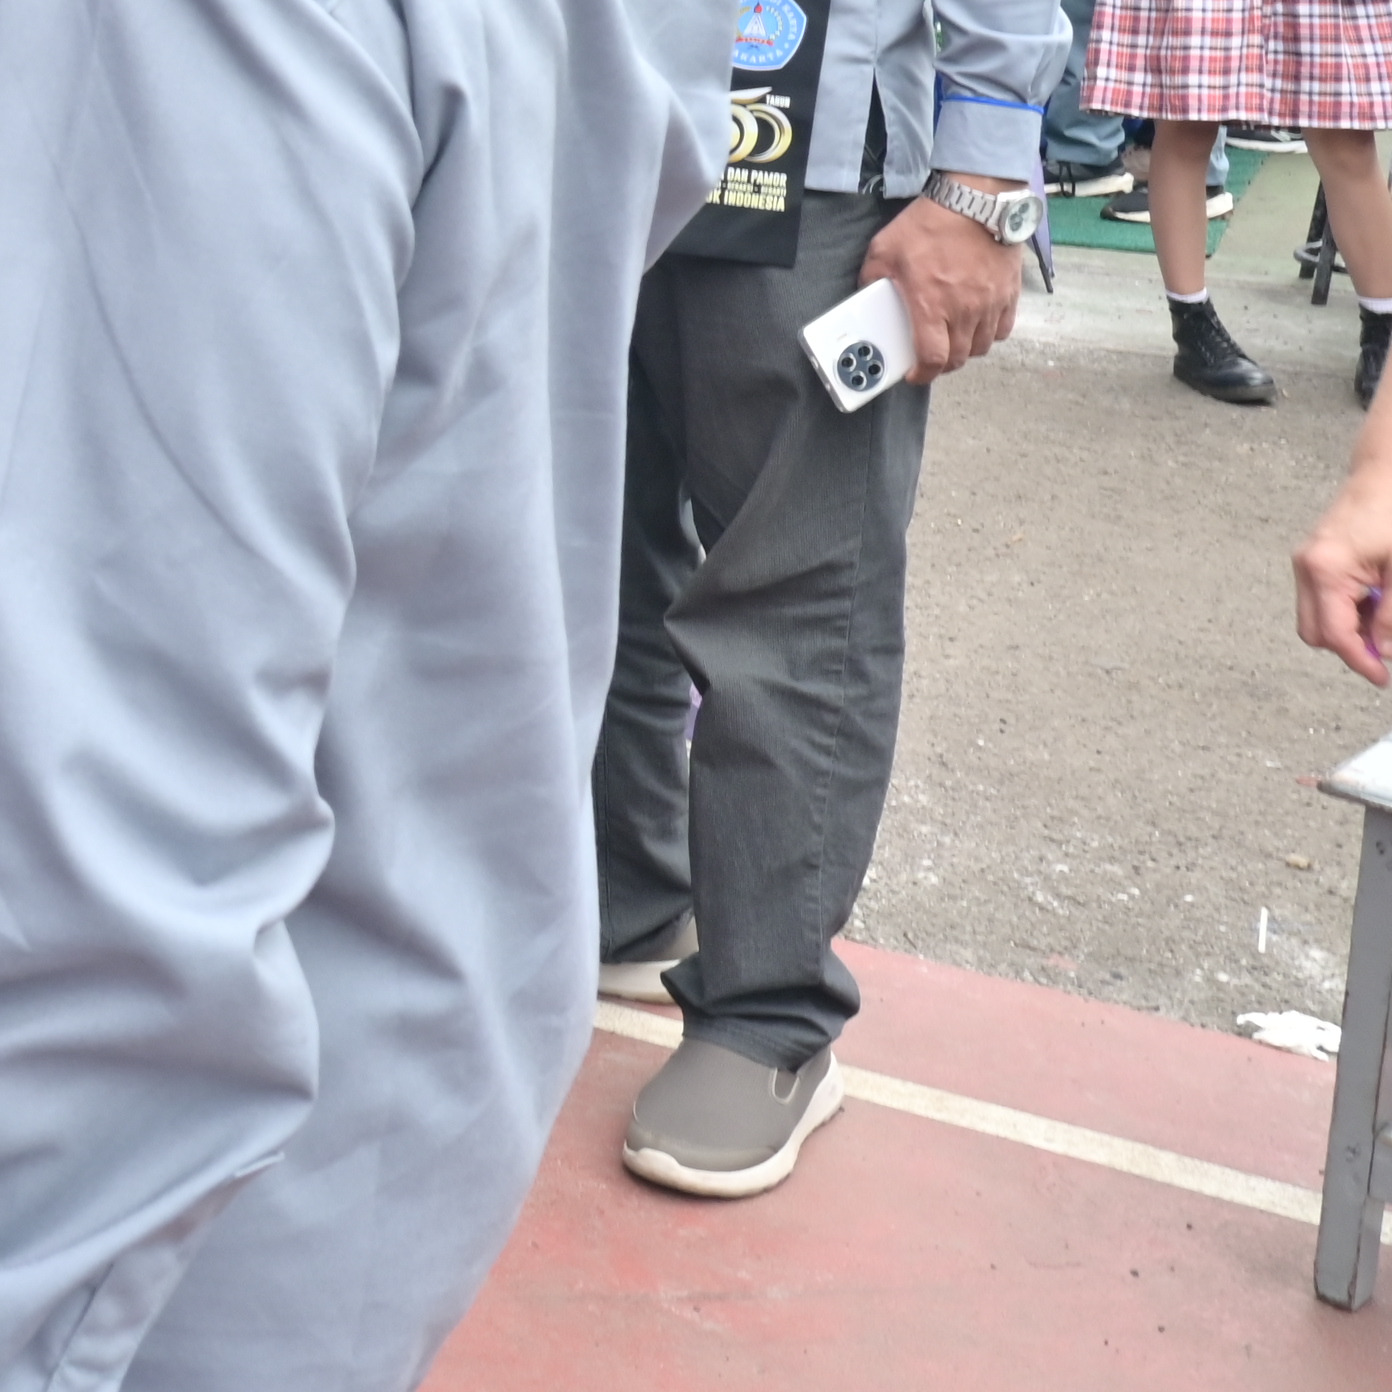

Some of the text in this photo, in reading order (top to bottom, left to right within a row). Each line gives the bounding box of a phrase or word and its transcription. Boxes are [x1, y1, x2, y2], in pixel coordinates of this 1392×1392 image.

[727, 167, 787, 188] DAN PAMOR
[723, 190, 785, 213] INDONESIA
